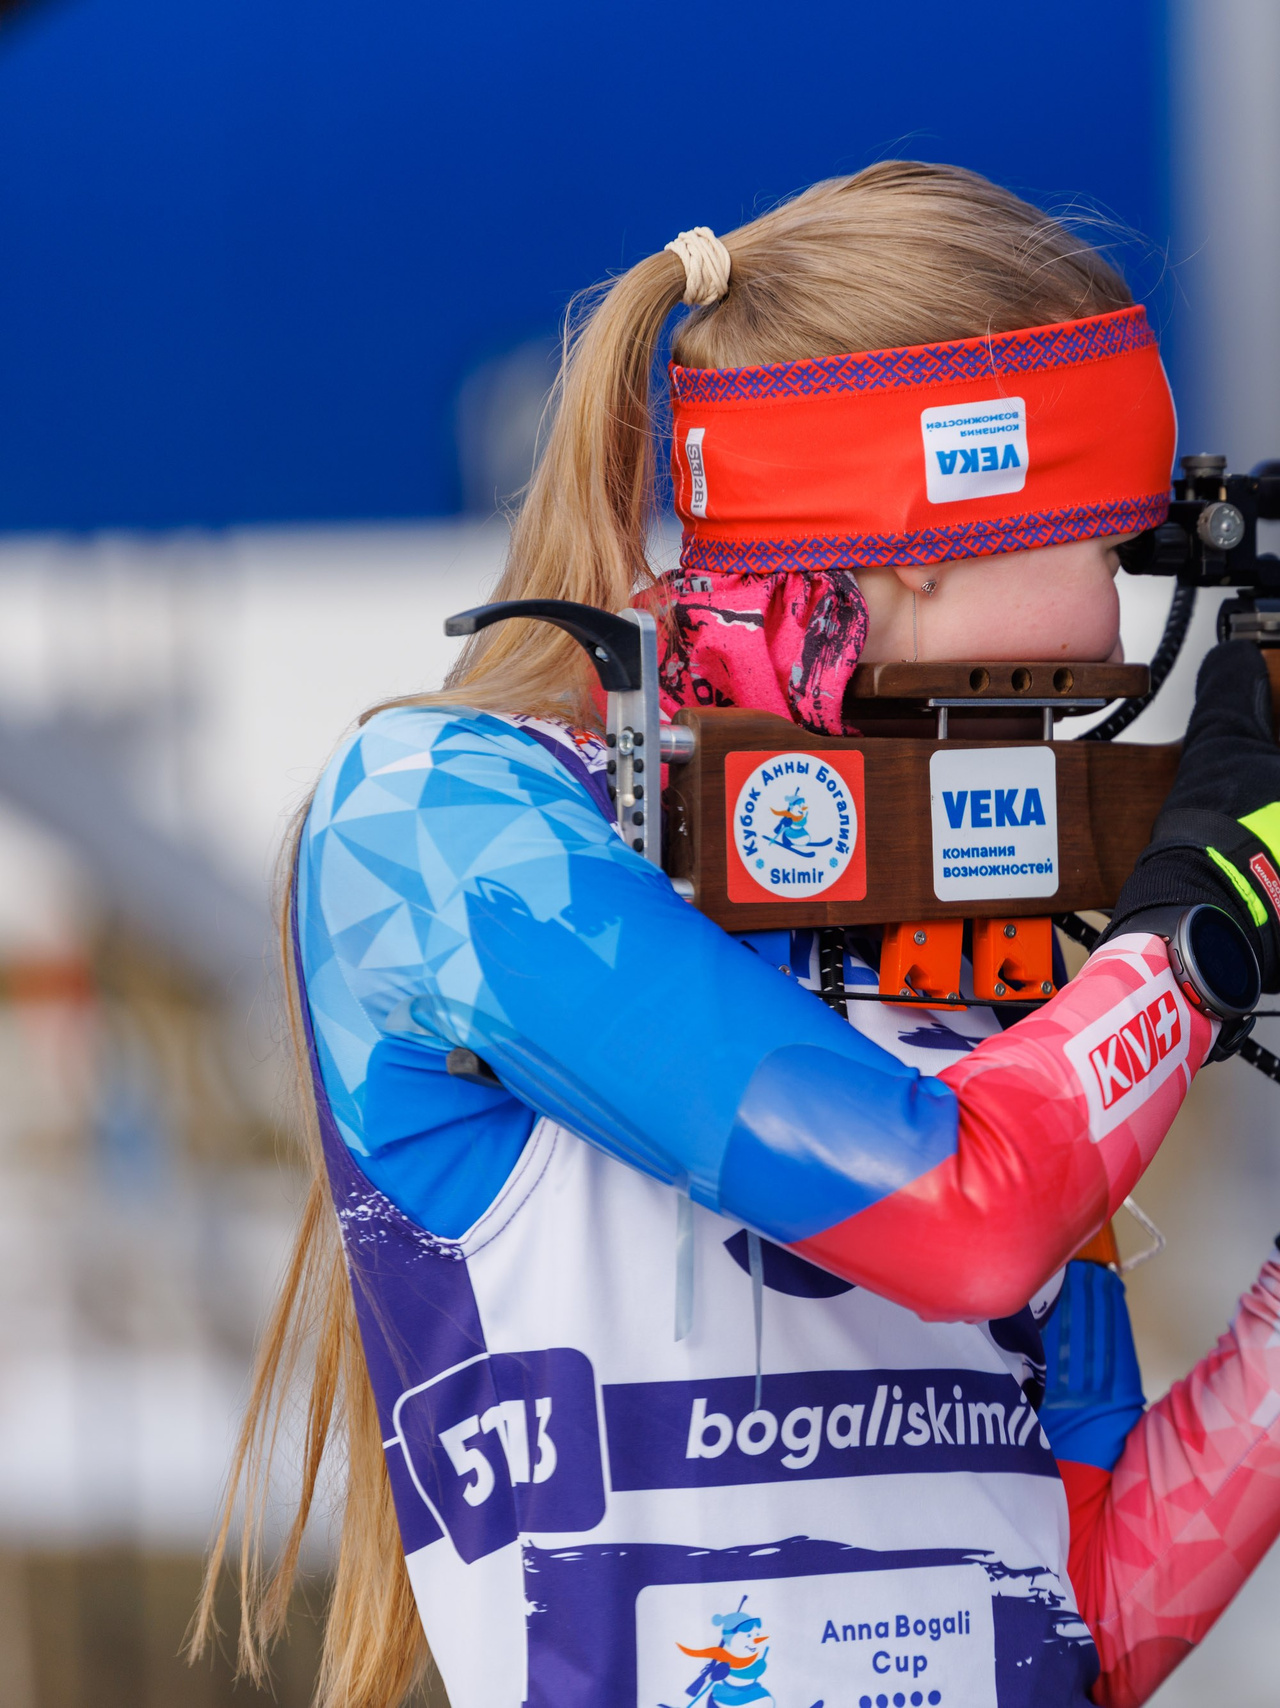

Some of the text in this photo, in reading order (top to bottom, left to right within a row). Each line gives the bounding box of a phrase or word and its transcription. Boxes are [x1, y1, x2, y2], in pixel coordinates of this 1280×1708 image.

[926, 411, 1020, 433] возможностей
[960, 424, 1020, 437] компания
[935, 444, 1021, 475] VEKA
[740, 761, 850, 857] Кубок Анны Богалий
[942, 788, 1046, 829] VEKA
[942, 845, 1016, 860] компания
[770, 868, 824, 885] Skimir
[943, 858, 1053, 878] возможностей
[821, 1610, 971, 1644] Anna Bogali
[872, 1650, 928, 1678] Cup
